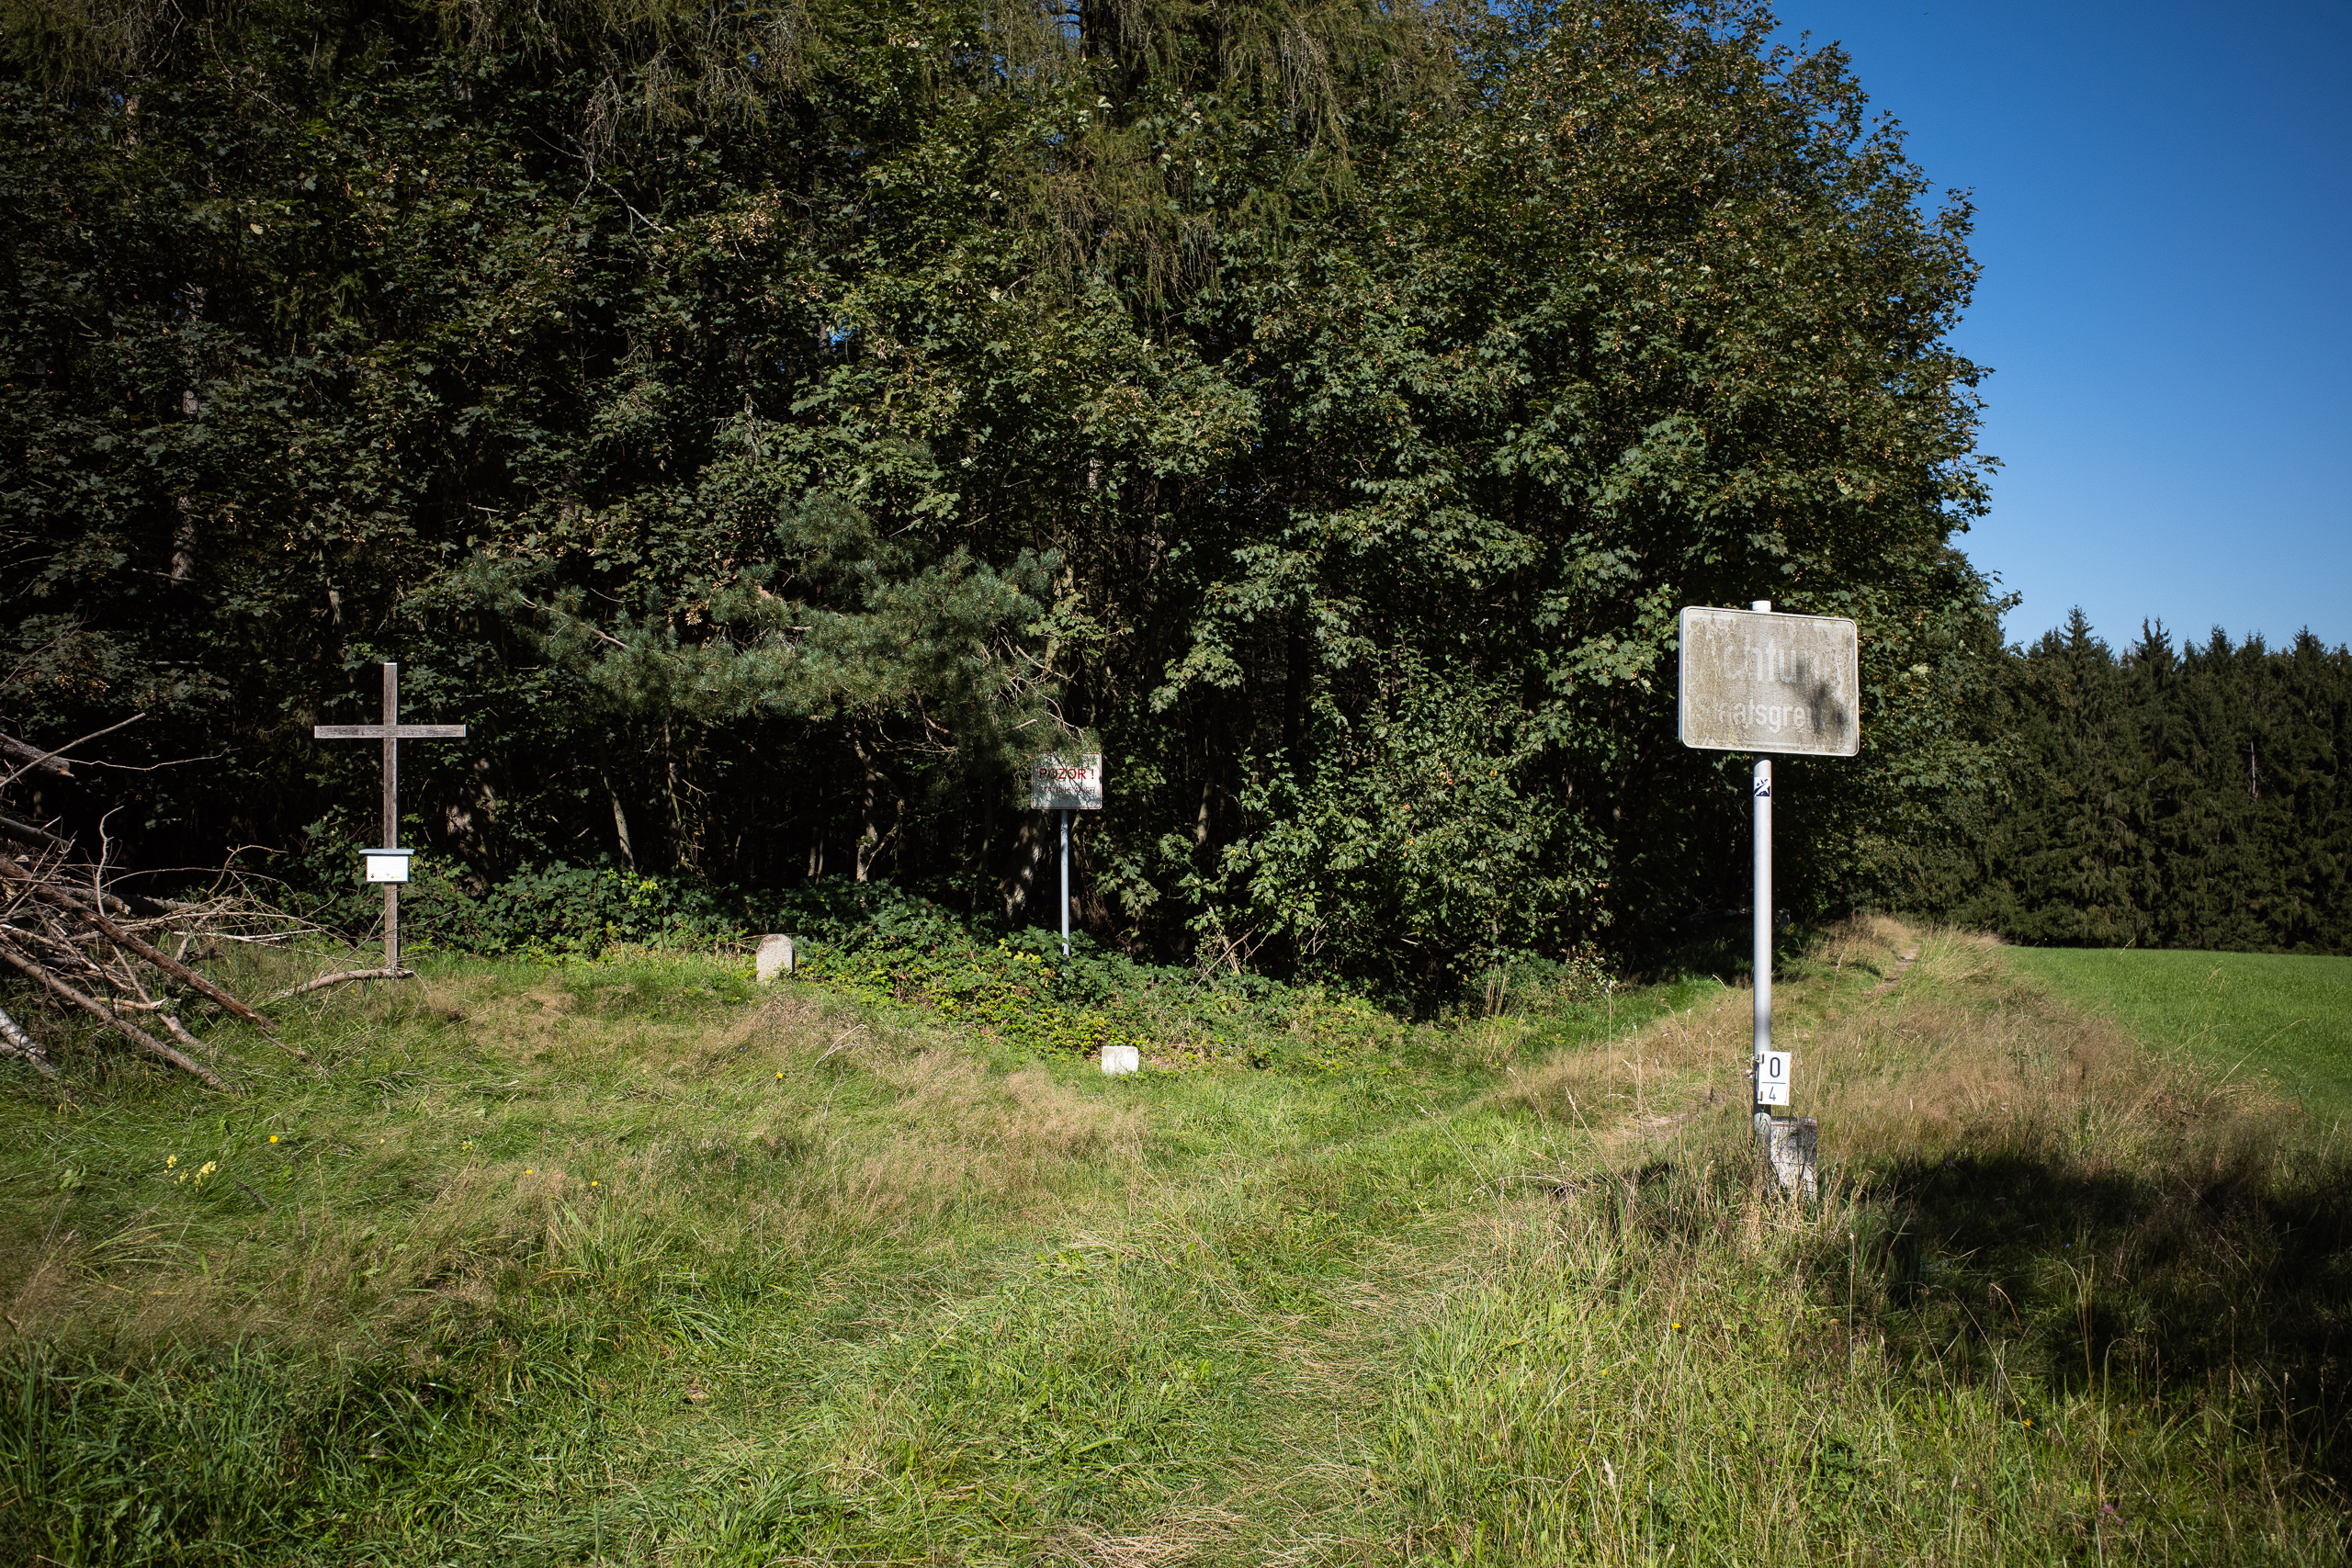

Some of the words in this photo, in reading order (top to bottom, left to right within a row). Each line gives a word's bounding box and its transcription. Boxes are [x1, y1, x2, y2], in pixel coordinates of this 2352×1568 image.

[1695, 693, 1844, 733] Staatsgre
[1039, 768, 1087, 780] POZOR
[1091, 768, 1094, 780] !
[1769, 1086, 1777, 1101] 4
